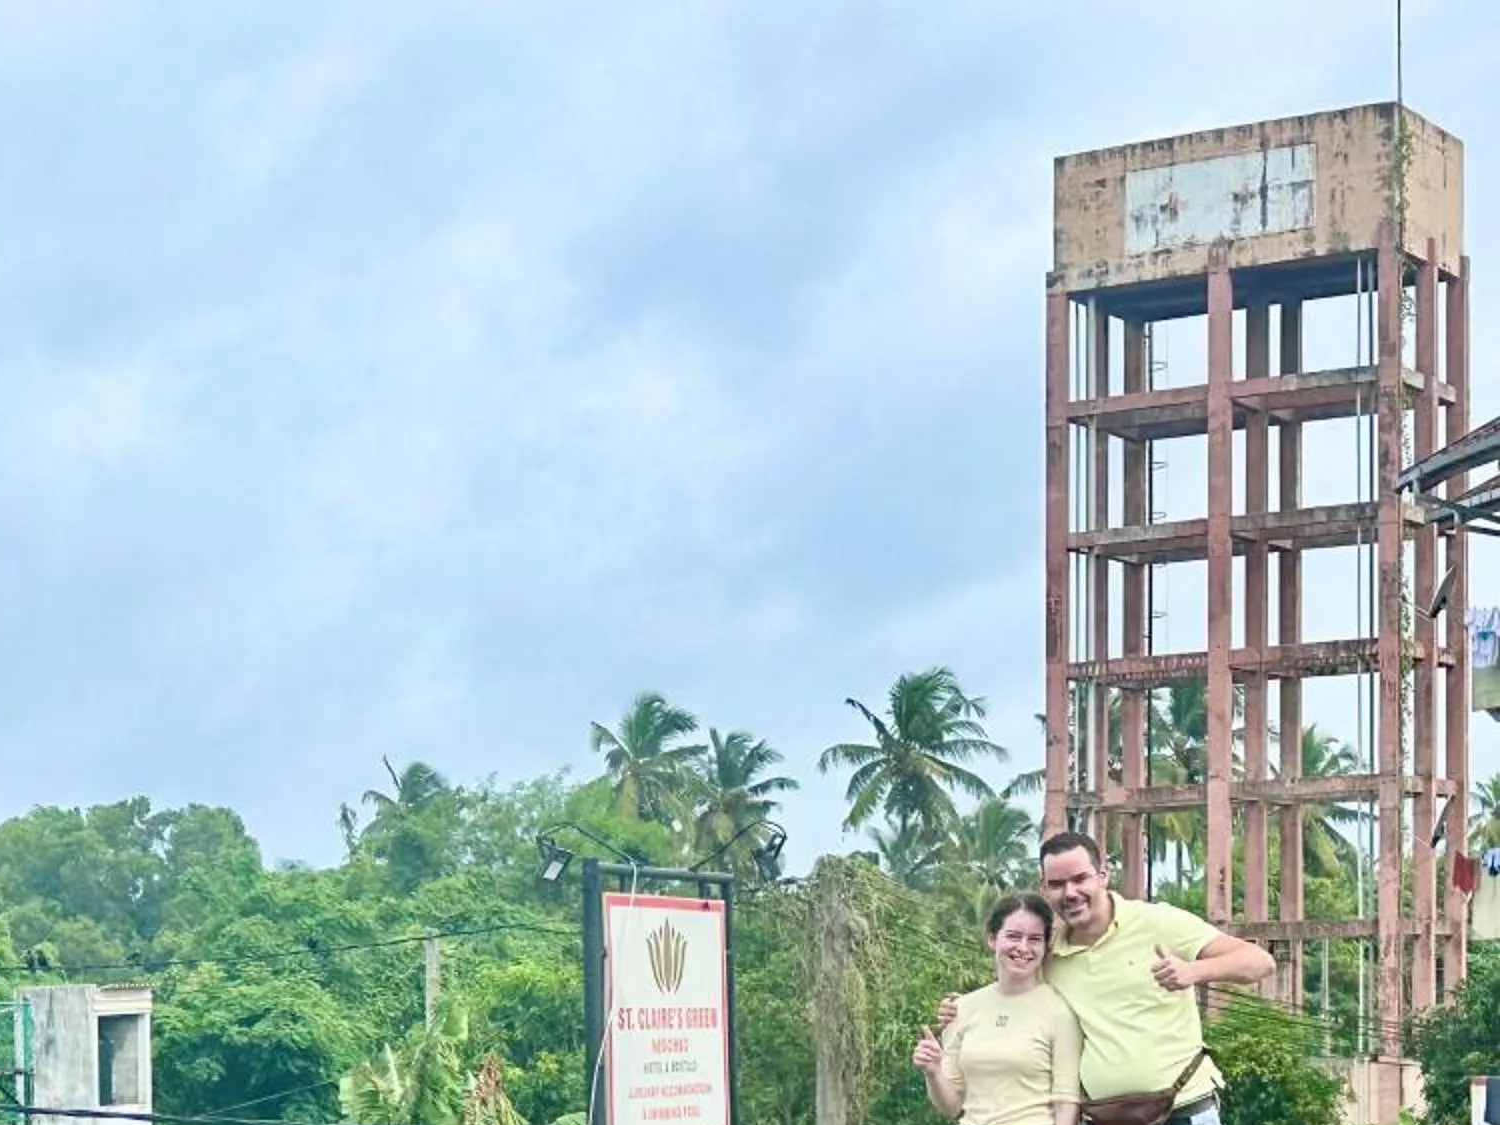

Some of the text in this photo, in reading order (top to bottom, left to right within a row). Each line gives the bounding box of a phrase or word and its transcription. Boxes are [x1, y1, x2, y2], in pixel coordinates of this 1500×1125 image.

[617, 1007, 717, 1030] ST. CLAIRE'S GREEN
